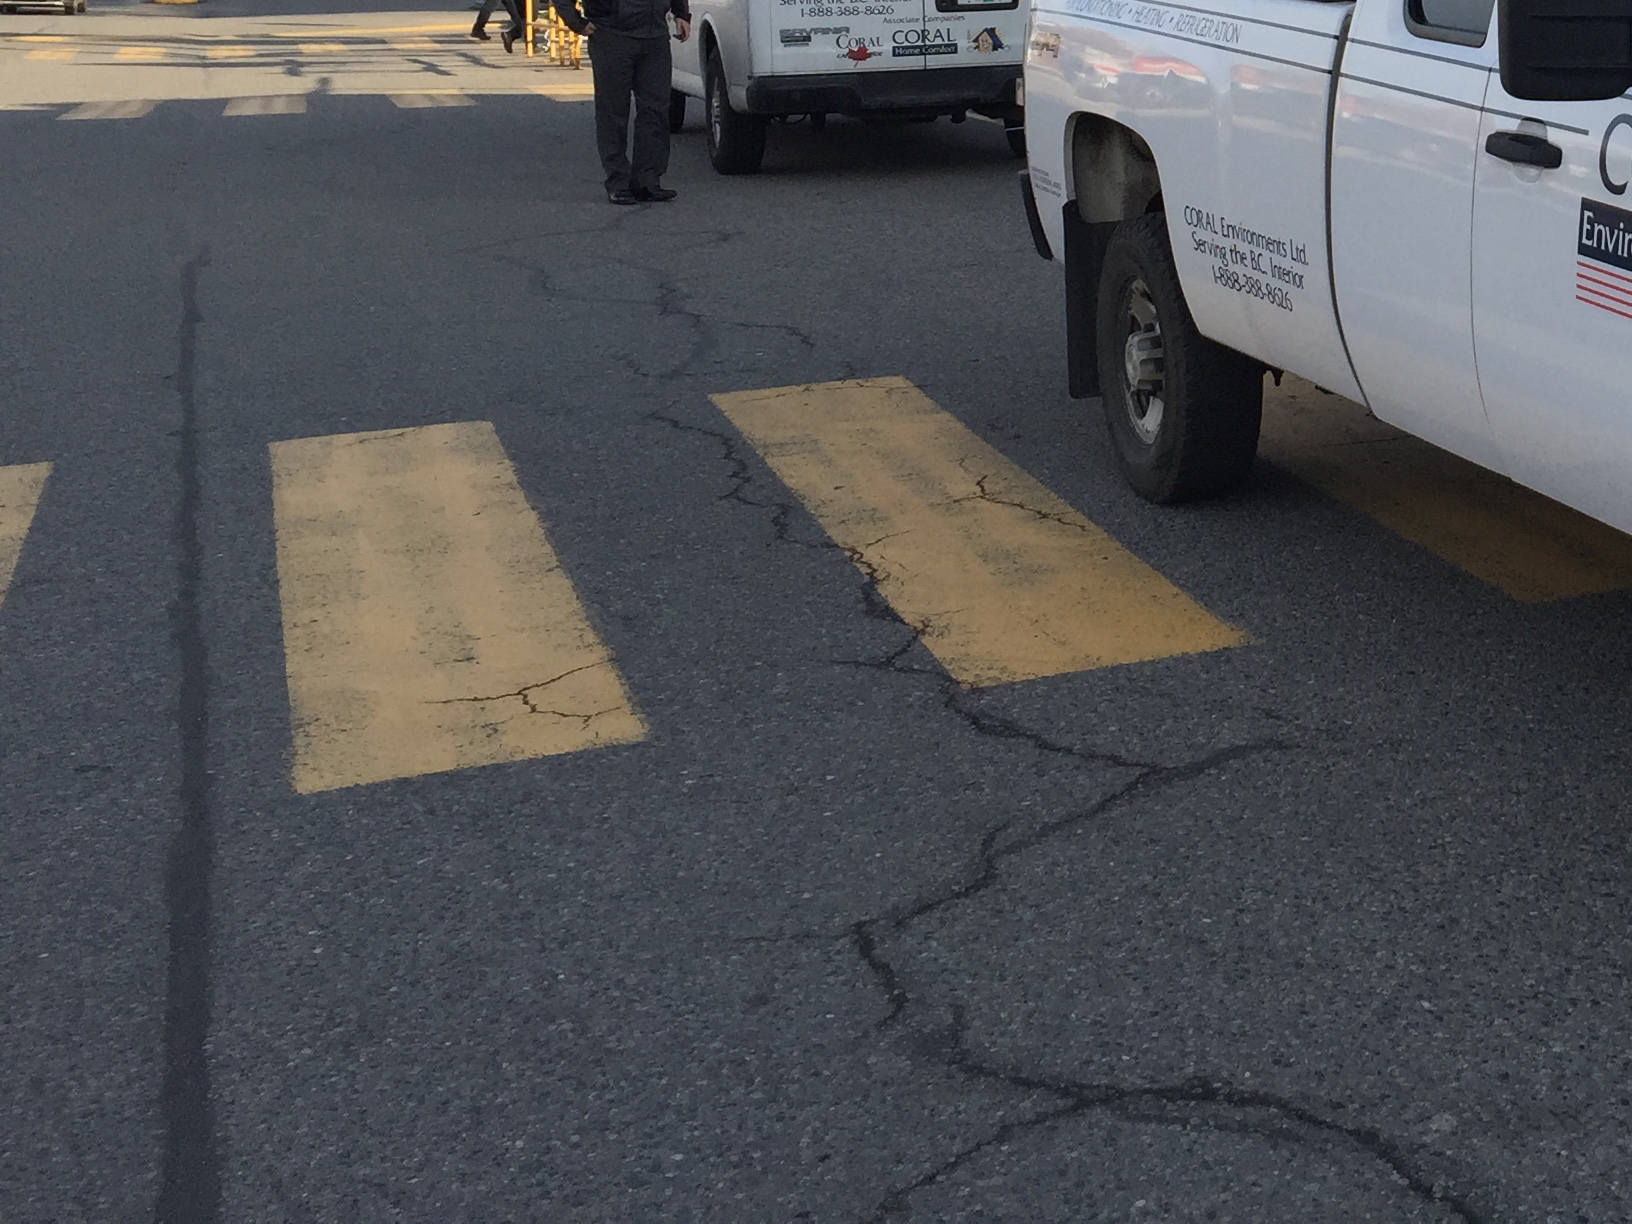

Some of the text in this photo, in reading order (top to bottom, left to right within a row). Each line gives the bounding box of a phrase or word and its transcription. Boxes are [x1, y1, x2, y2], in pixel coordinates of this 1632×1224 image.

[800, 4, 895, 18] 1-888-388-8626
[883, 14, 966, 25] Associate Companies
[1132, 5, 1170, 28] HEATING
[1173, 13, 1243, 44] REFRIGERATION
[892, 27, 957, 45] CORAL
[895, 46, 921, 55] Home
[922, 45, 956, 55] Comfort
[1184, 205, 1309, 266] CORAL Environments Ltd.
[1191, 231, 1229, 267] Serving
[1230, 244, 1248, 267] the
[1212, 264, 1293, 312] 1-888-388-8626
